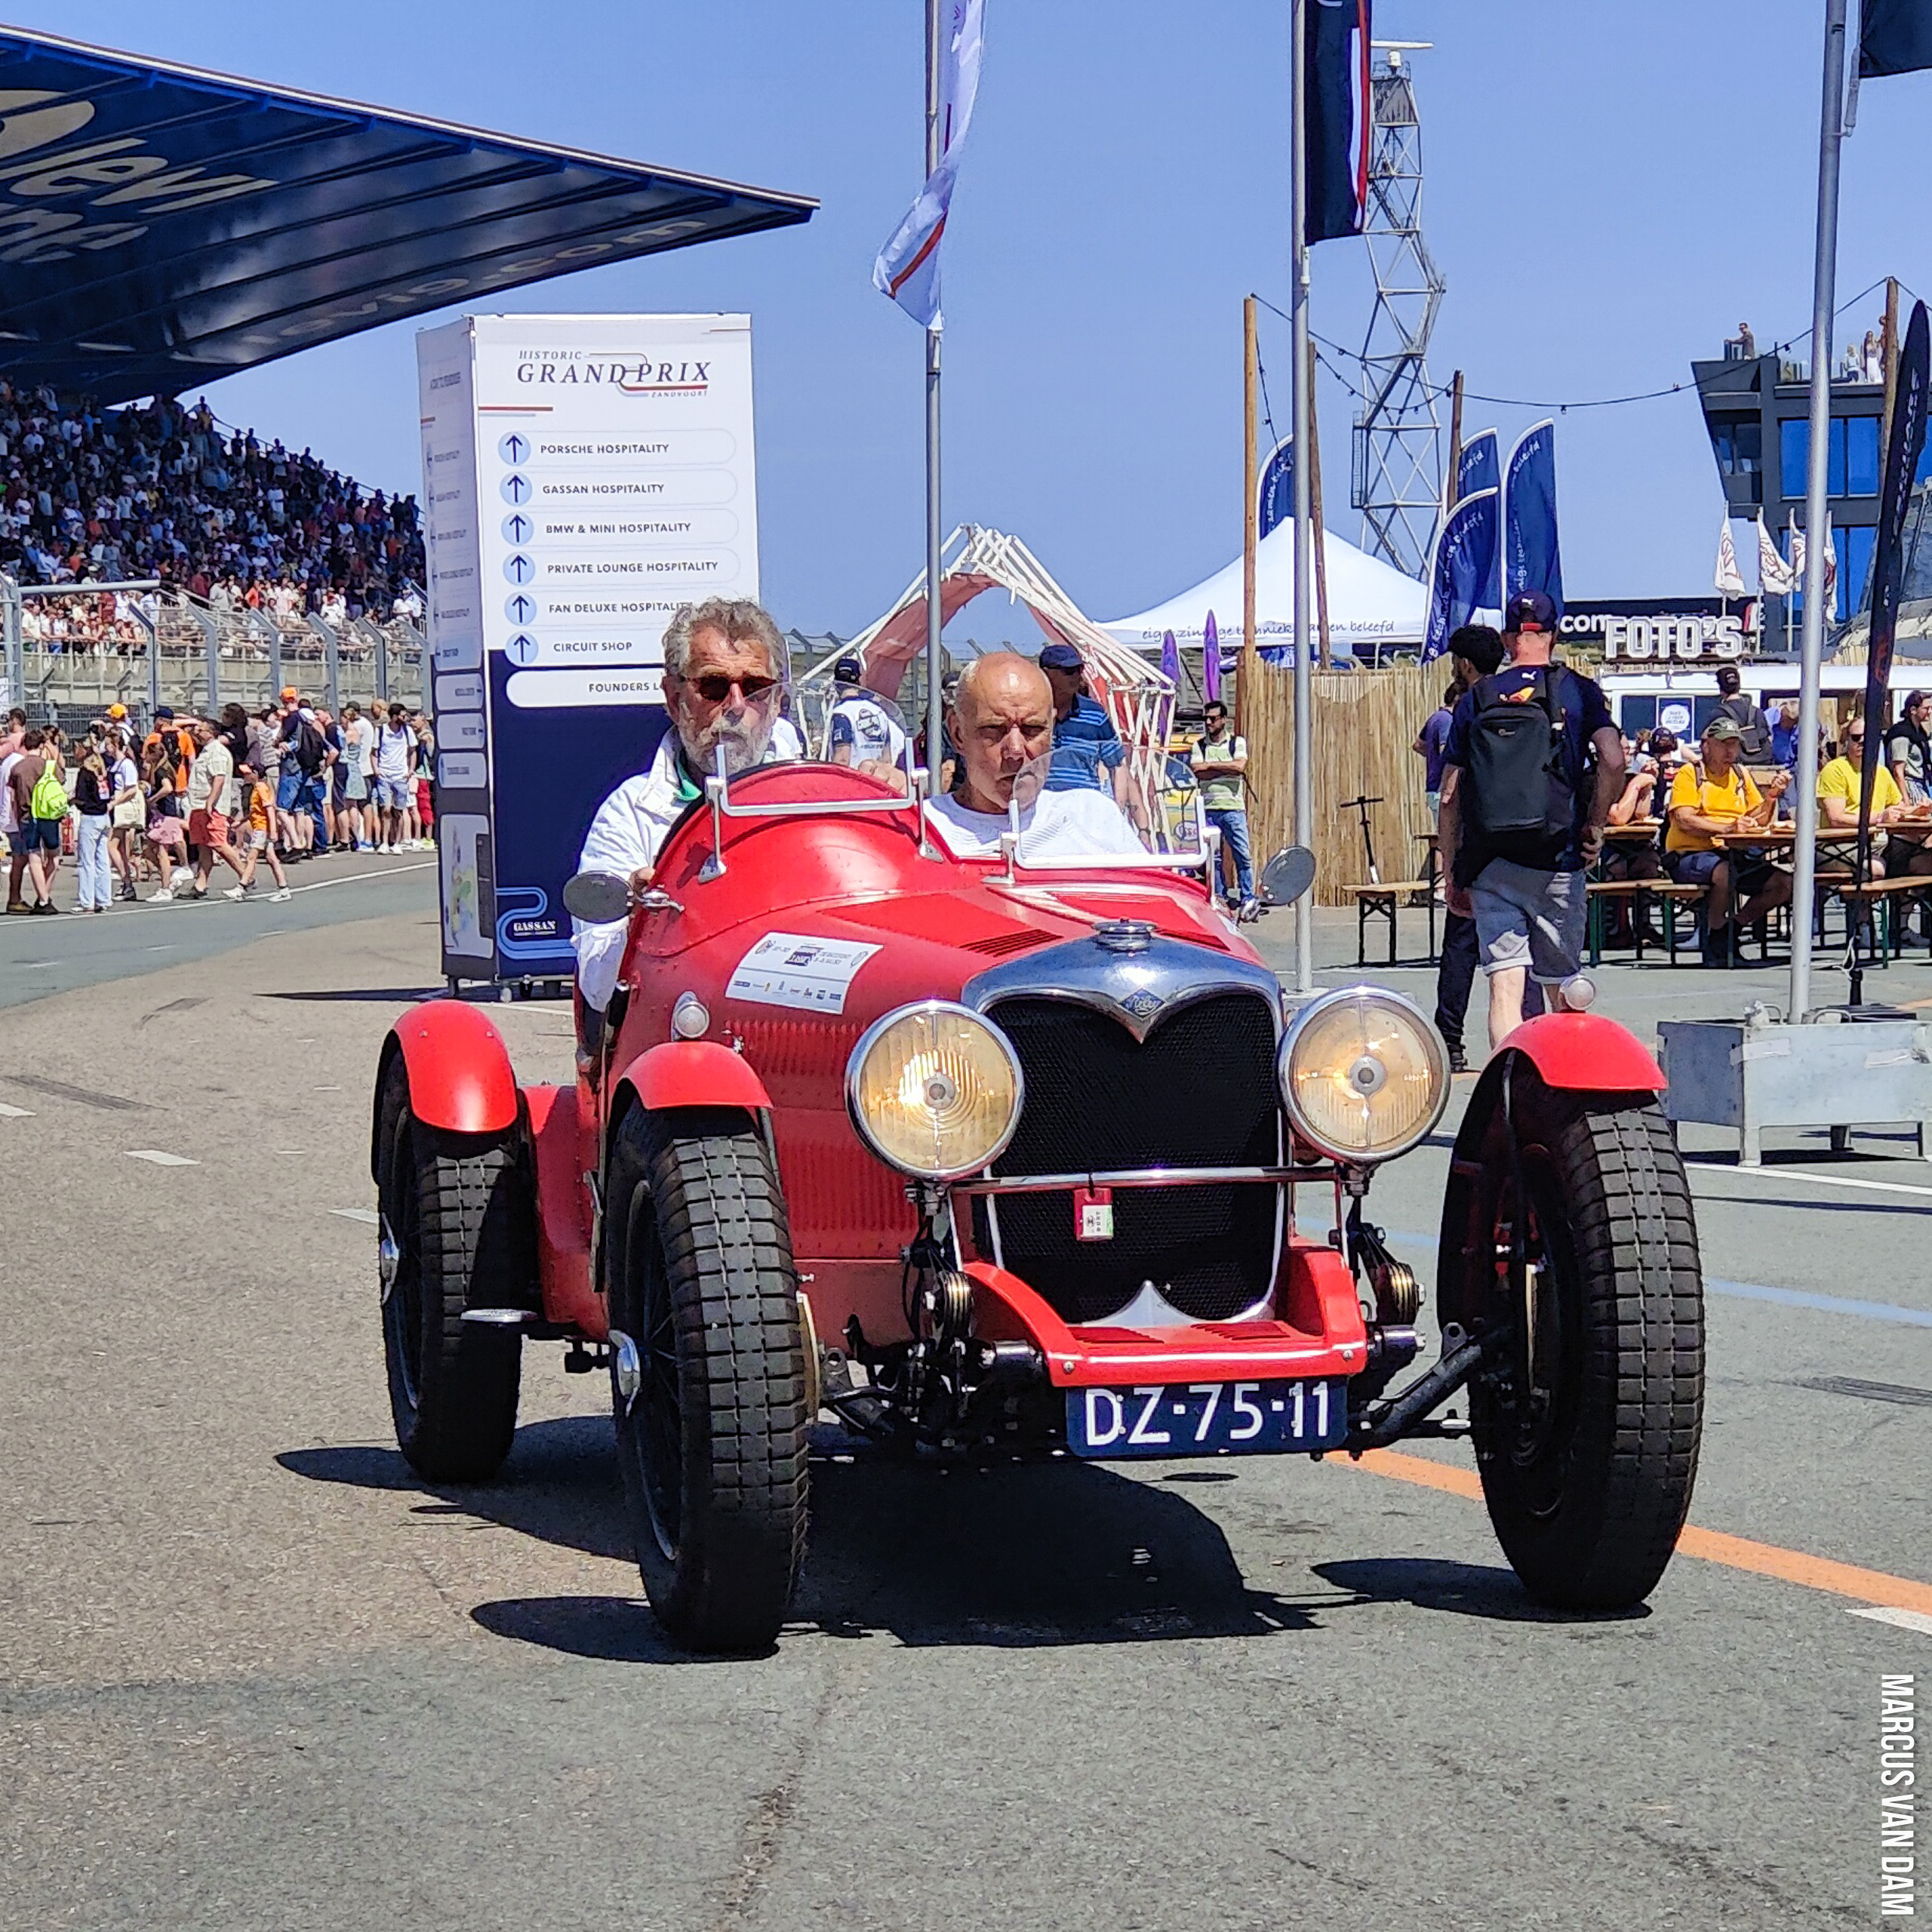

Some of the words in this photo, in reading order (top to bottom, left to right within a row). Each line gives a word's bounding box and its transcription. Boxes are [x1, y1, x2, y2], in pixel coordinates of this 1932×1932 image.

[518, 350, 583, 360] HISTORIC
[517, 363, 626, 383] GRAND
[635, 361, 711, 383] PRIX
[540, 445, 593, 454] PORSCHE
[597, 444, 669, 453] HOSPITALITY
[543, 485, 589, 494] GASSAN
[592, 484, 665, 494] HOSPITALITY
[546, 525, 574, 534] BMW
[578, 525, 586, 534] &
[589, 524, 616, 534] MINI
[619, 523, 691, 533] HOSPITALITY
[548, 565, 593, 574] PRIVATE
[597, 563, 643, 573] LOUNGE
[647, 561, 718, 572] HOSPITALITY
[549, 604, 571, 614] FAN
[574, 603, 617, 613] DELUXE
[1350, 620, 1395, 635] beleefd
[1604, 615, 1743, 659] FOTO'S
[553, 642, 598, 653] CIRCUIT
[601, 641, 632, 652] SHOP
[589, 682, 650, 693] FOUNDERS
[513, 920, 557, 932] GASSAN
[1084, 1381, 1328, 1446] DZ-75-11
